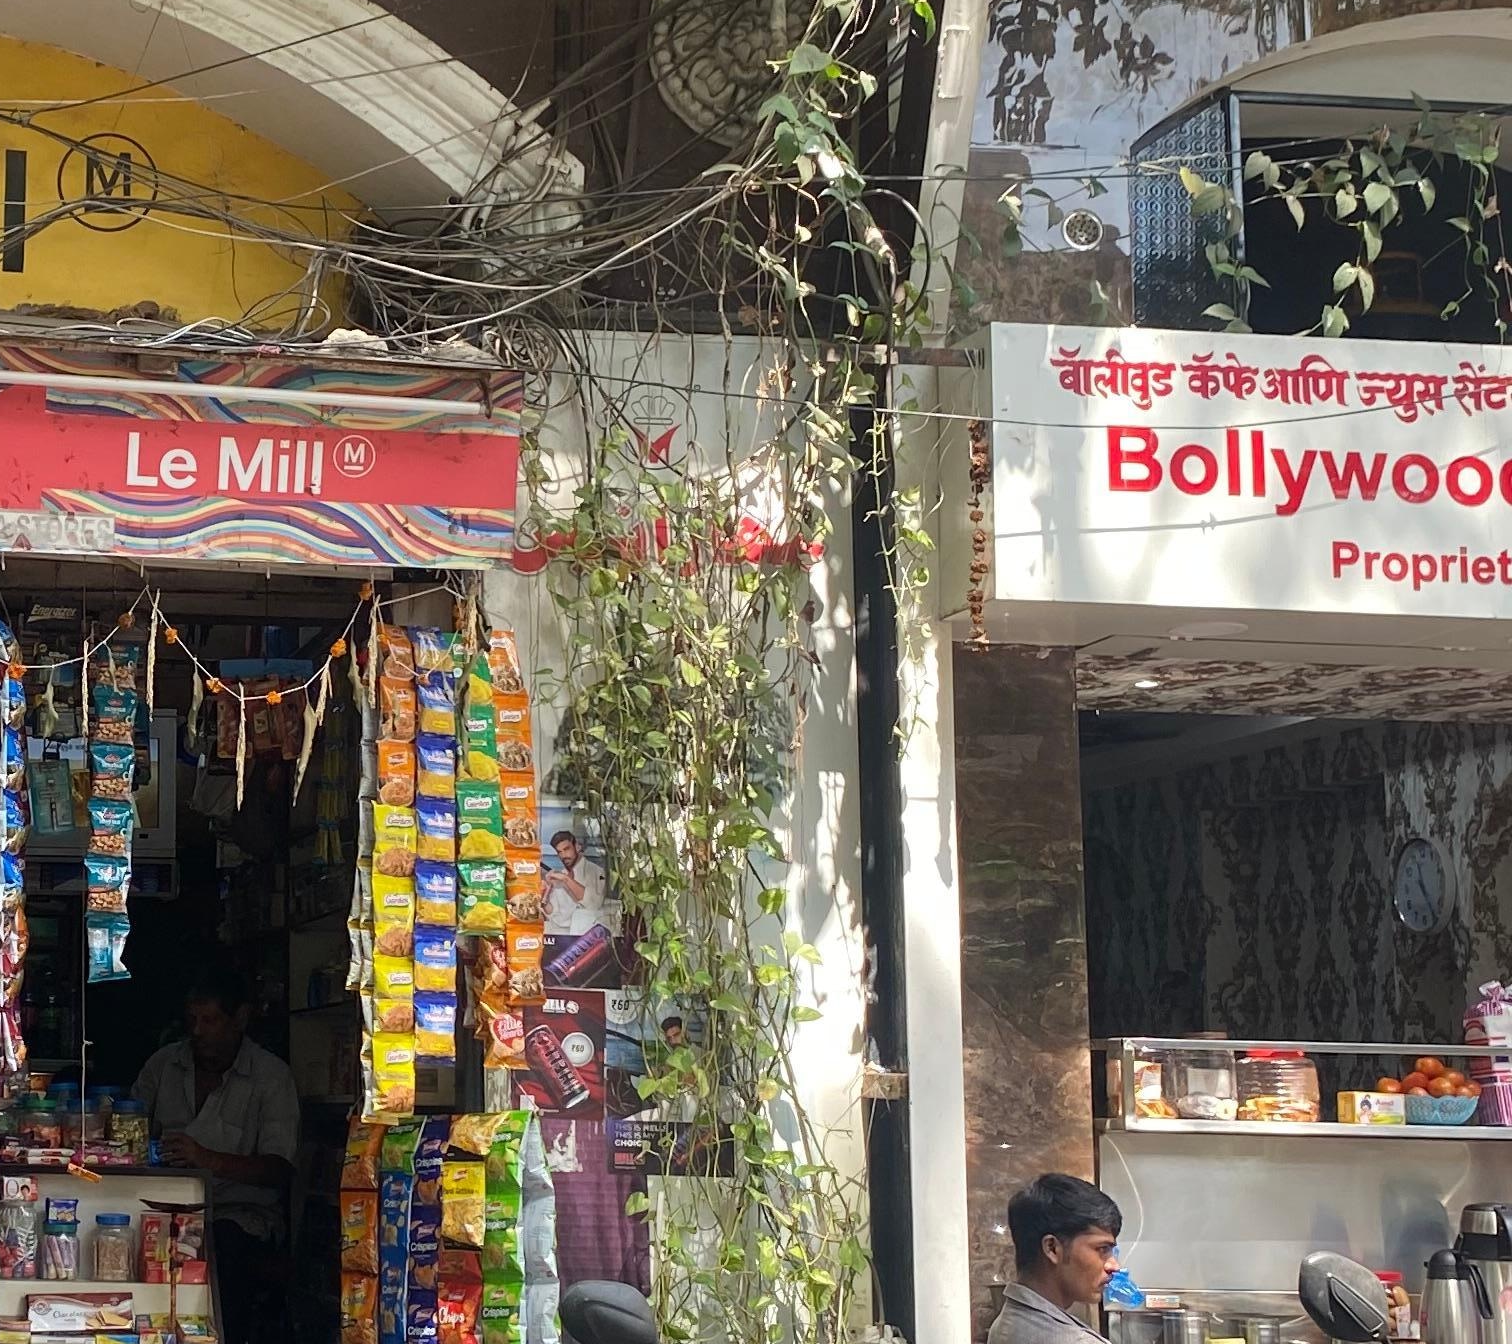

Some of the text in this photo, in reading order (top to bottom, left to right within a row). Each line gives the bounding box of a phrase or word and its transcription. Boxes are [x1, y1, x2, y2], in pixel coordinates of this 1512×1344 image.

[125, 432, 197, 488] Le
[218, 441, 324, 495] Mill
[1107, 426, 1512, 516] Bollywoo
[438, 1307, 465, 1324] Chips
